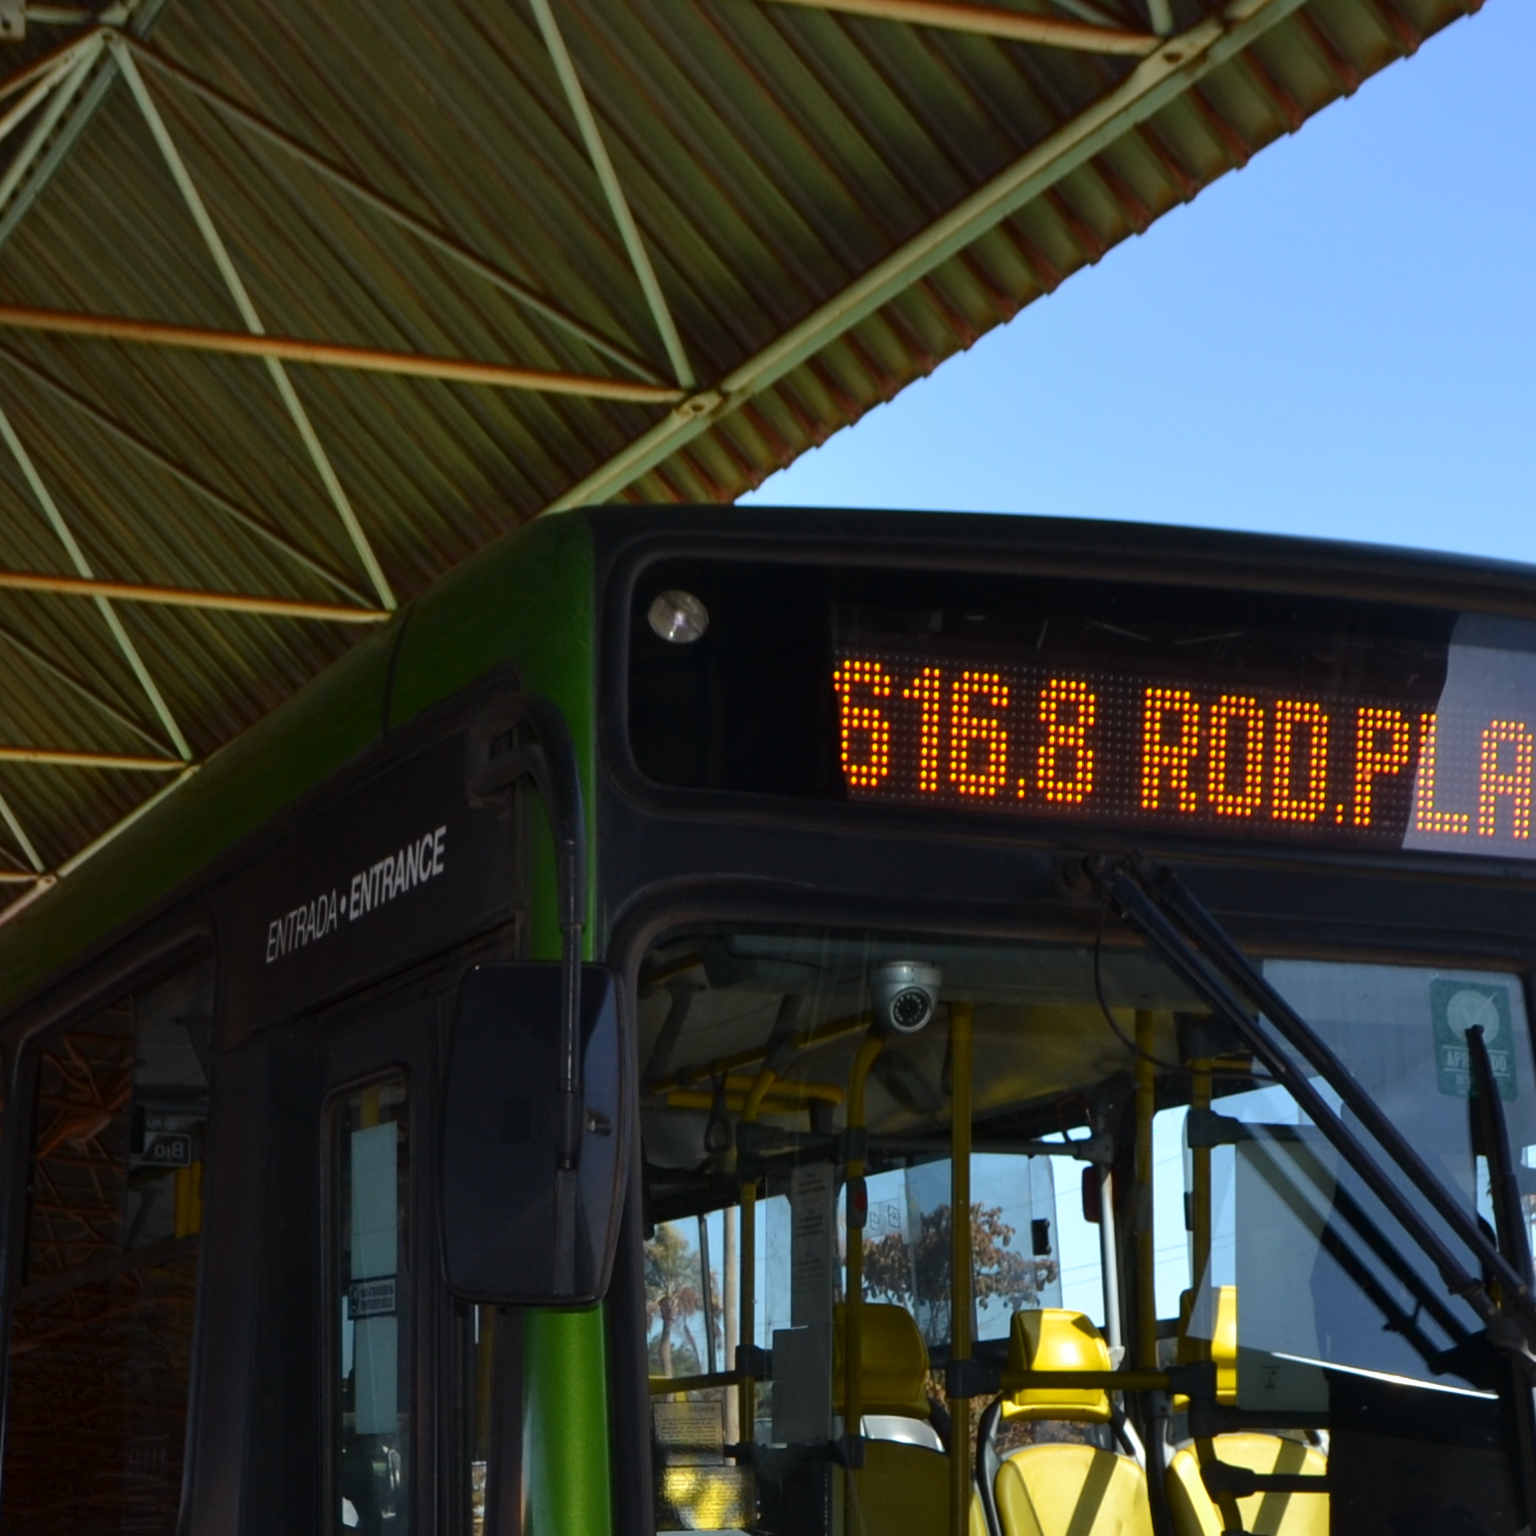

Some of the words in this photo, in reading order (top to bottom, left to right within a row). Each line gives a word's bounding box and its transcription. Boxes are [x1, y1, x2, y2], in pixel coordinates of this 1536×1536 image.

[833, 658, 1097, 804] 616.8
[265, 888, 338, 964] ENTRADA
[348, 824, 447, 922] ENTRANCE
